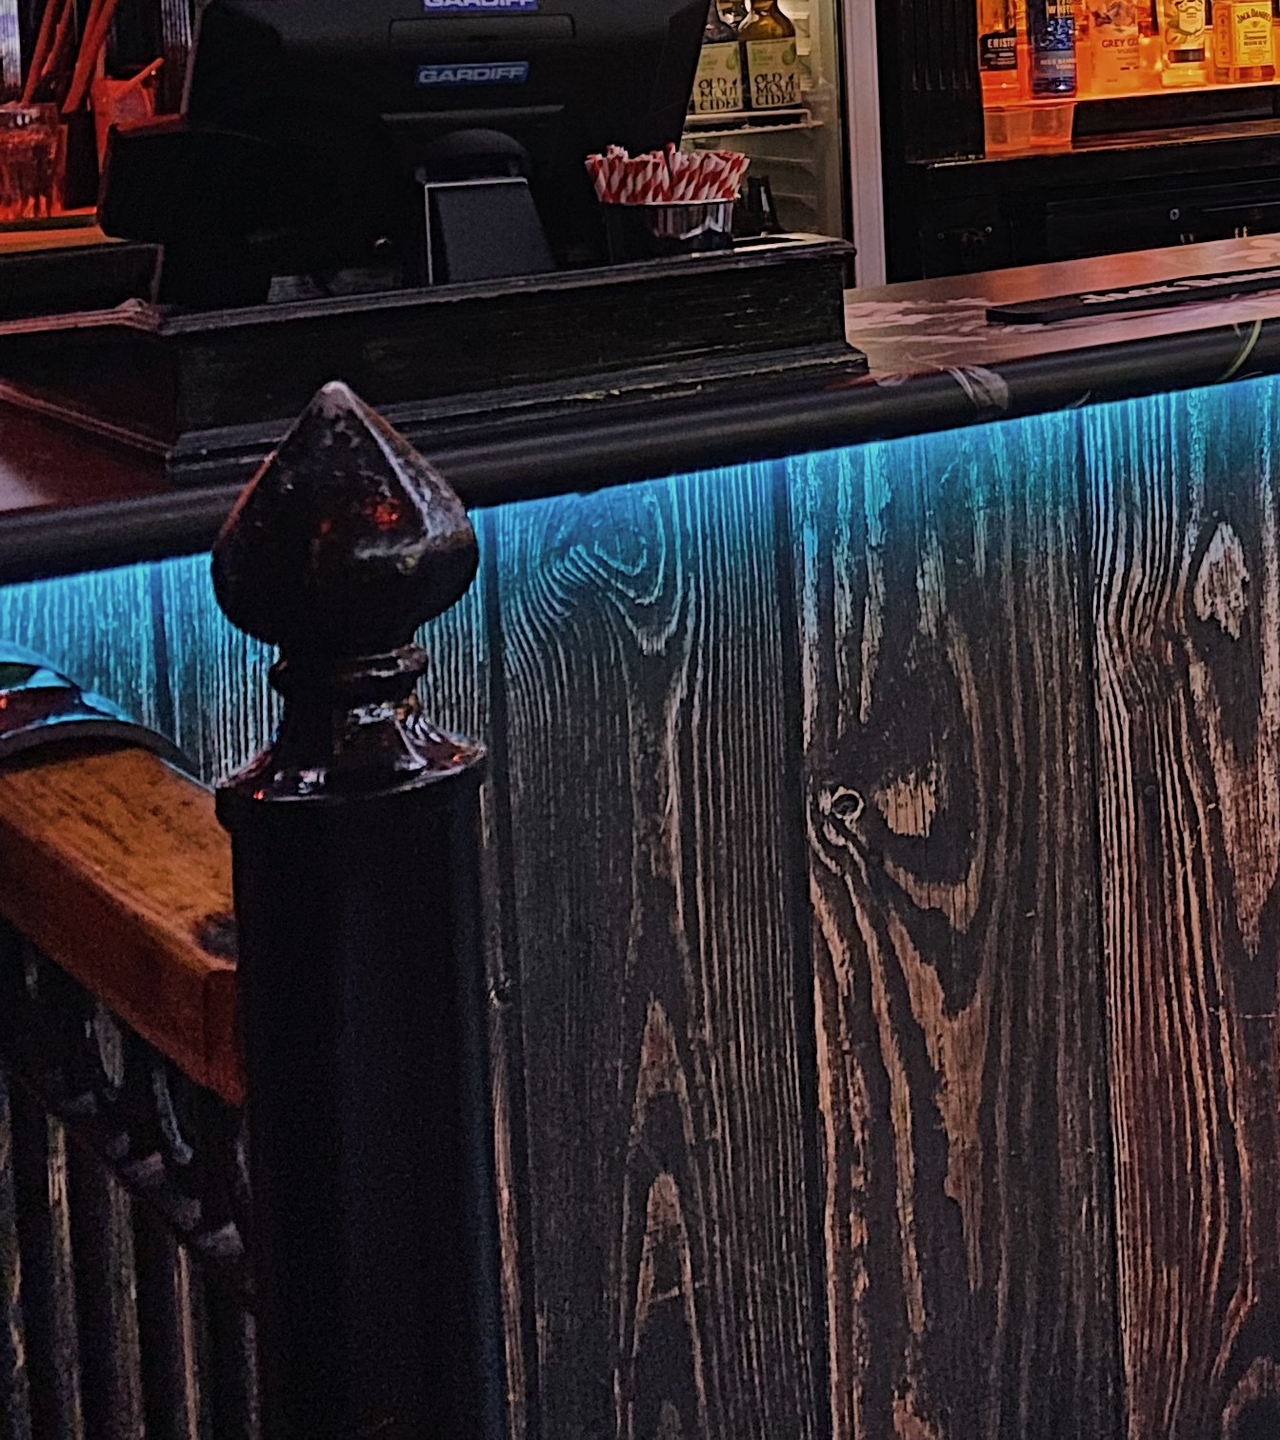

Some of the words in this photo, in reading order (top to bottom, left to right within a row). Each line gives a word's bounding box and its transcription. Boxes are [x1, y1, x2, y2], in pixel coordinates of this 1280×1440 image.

[1101, 38, 1125, 48] GREY
[418, 67, 525, 82] GARDIFF
[754, 73, 783, 85] OLD
[698, 78, 727, 90] OLD
[700, 98, 740, 111] CIDER
[755, 92, 797, 106] CIDER
